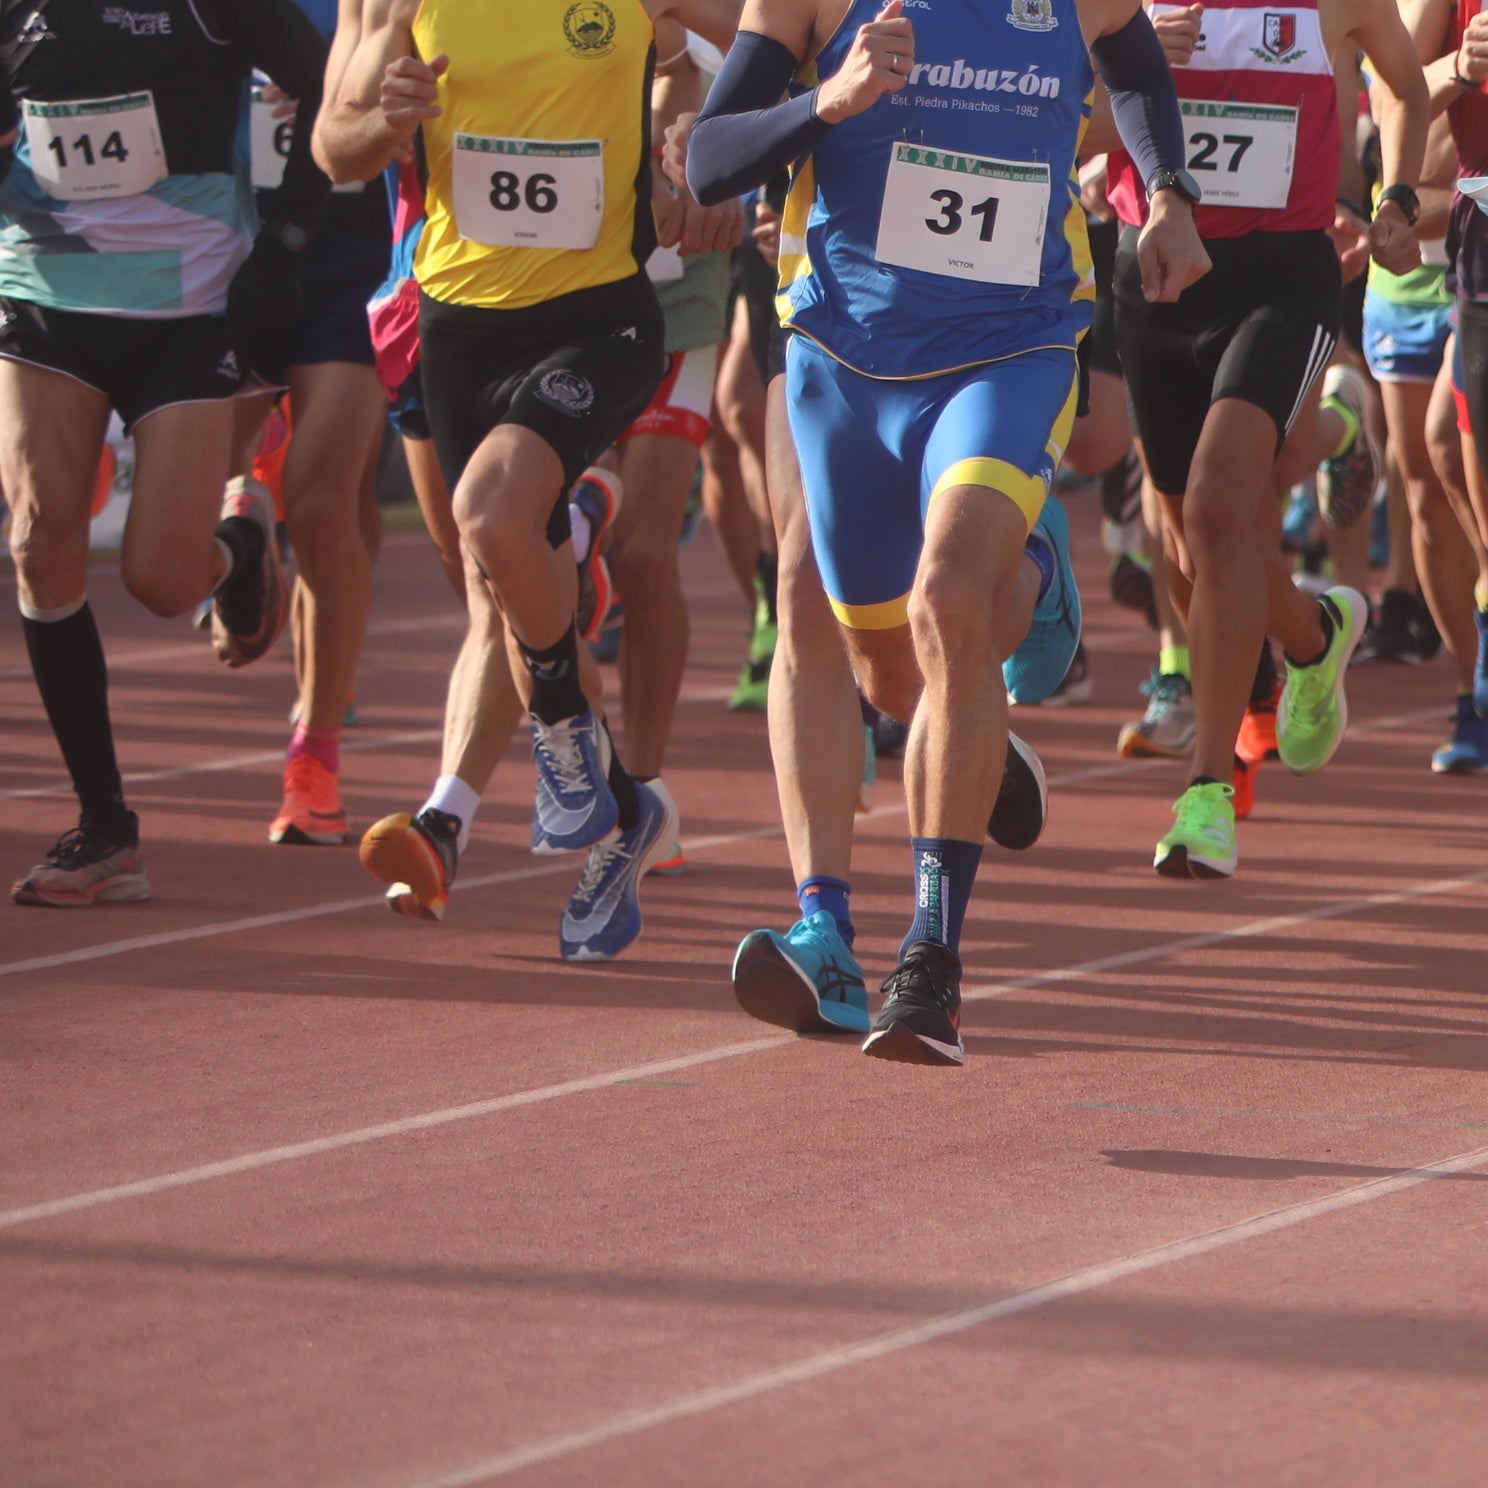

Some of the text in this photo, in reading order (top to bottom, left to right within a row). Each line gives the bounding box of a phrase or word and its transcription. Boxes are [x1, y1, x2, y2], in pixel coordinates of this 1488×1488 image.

[905, 59, 1061, 99] rabuzón
[890, 94, 912, 107] Est.
[914, 95, 948, 109] Piedra
[951, 99, 1000, 113] Pikachos
[48, 130, 129, 168] 114
[457, 135, 527, 155] XXXIV
[899, 145, 978, 173] XXXIV
[1012, 172, 1024, 181] DE
[1187, 132, 1254, 173] 27
[489, 170, 558, 214] 86
[925, 189, 1000, 243] 31
[948, 258, 975, 270] VICTOR
[919, 873, 929, 908] CROSS
